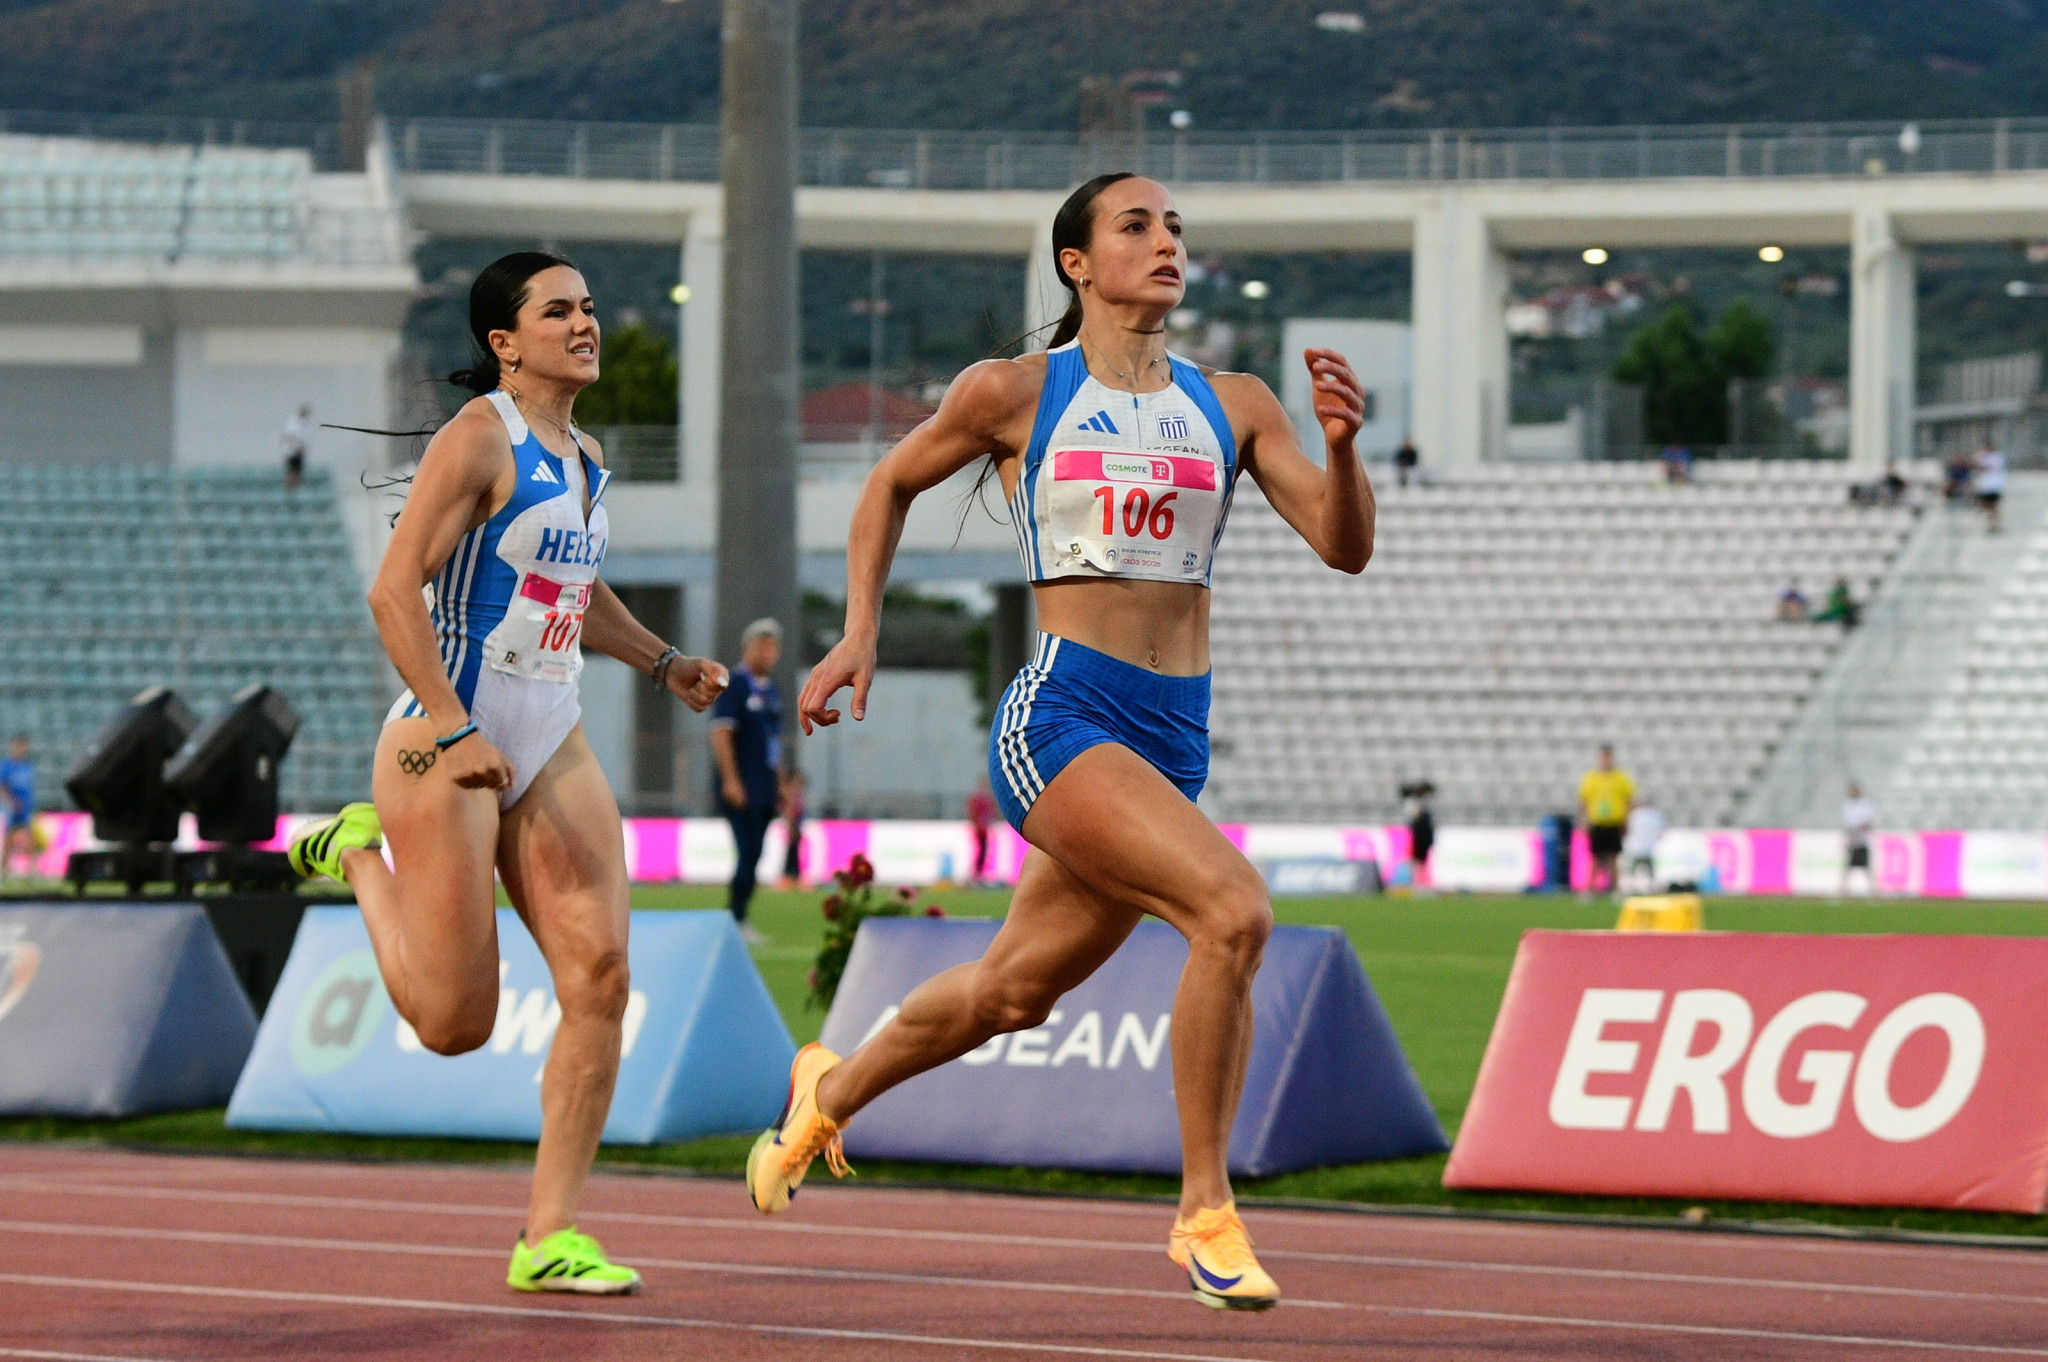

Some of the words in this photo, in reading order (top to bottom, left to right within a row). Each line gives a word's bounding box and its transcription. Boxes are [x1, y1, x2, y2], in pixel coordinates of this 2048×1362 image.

[1106, 463, 1148, 473] COSMOTE
[1147, 445, 1199, 454] GEAN
[1094, 485, 1178, 540] 106
[535, 527, 606, 568] HELLA
[539, 611, 583, 653] 107
[1548, 987, 1987, 1143] ERGO
